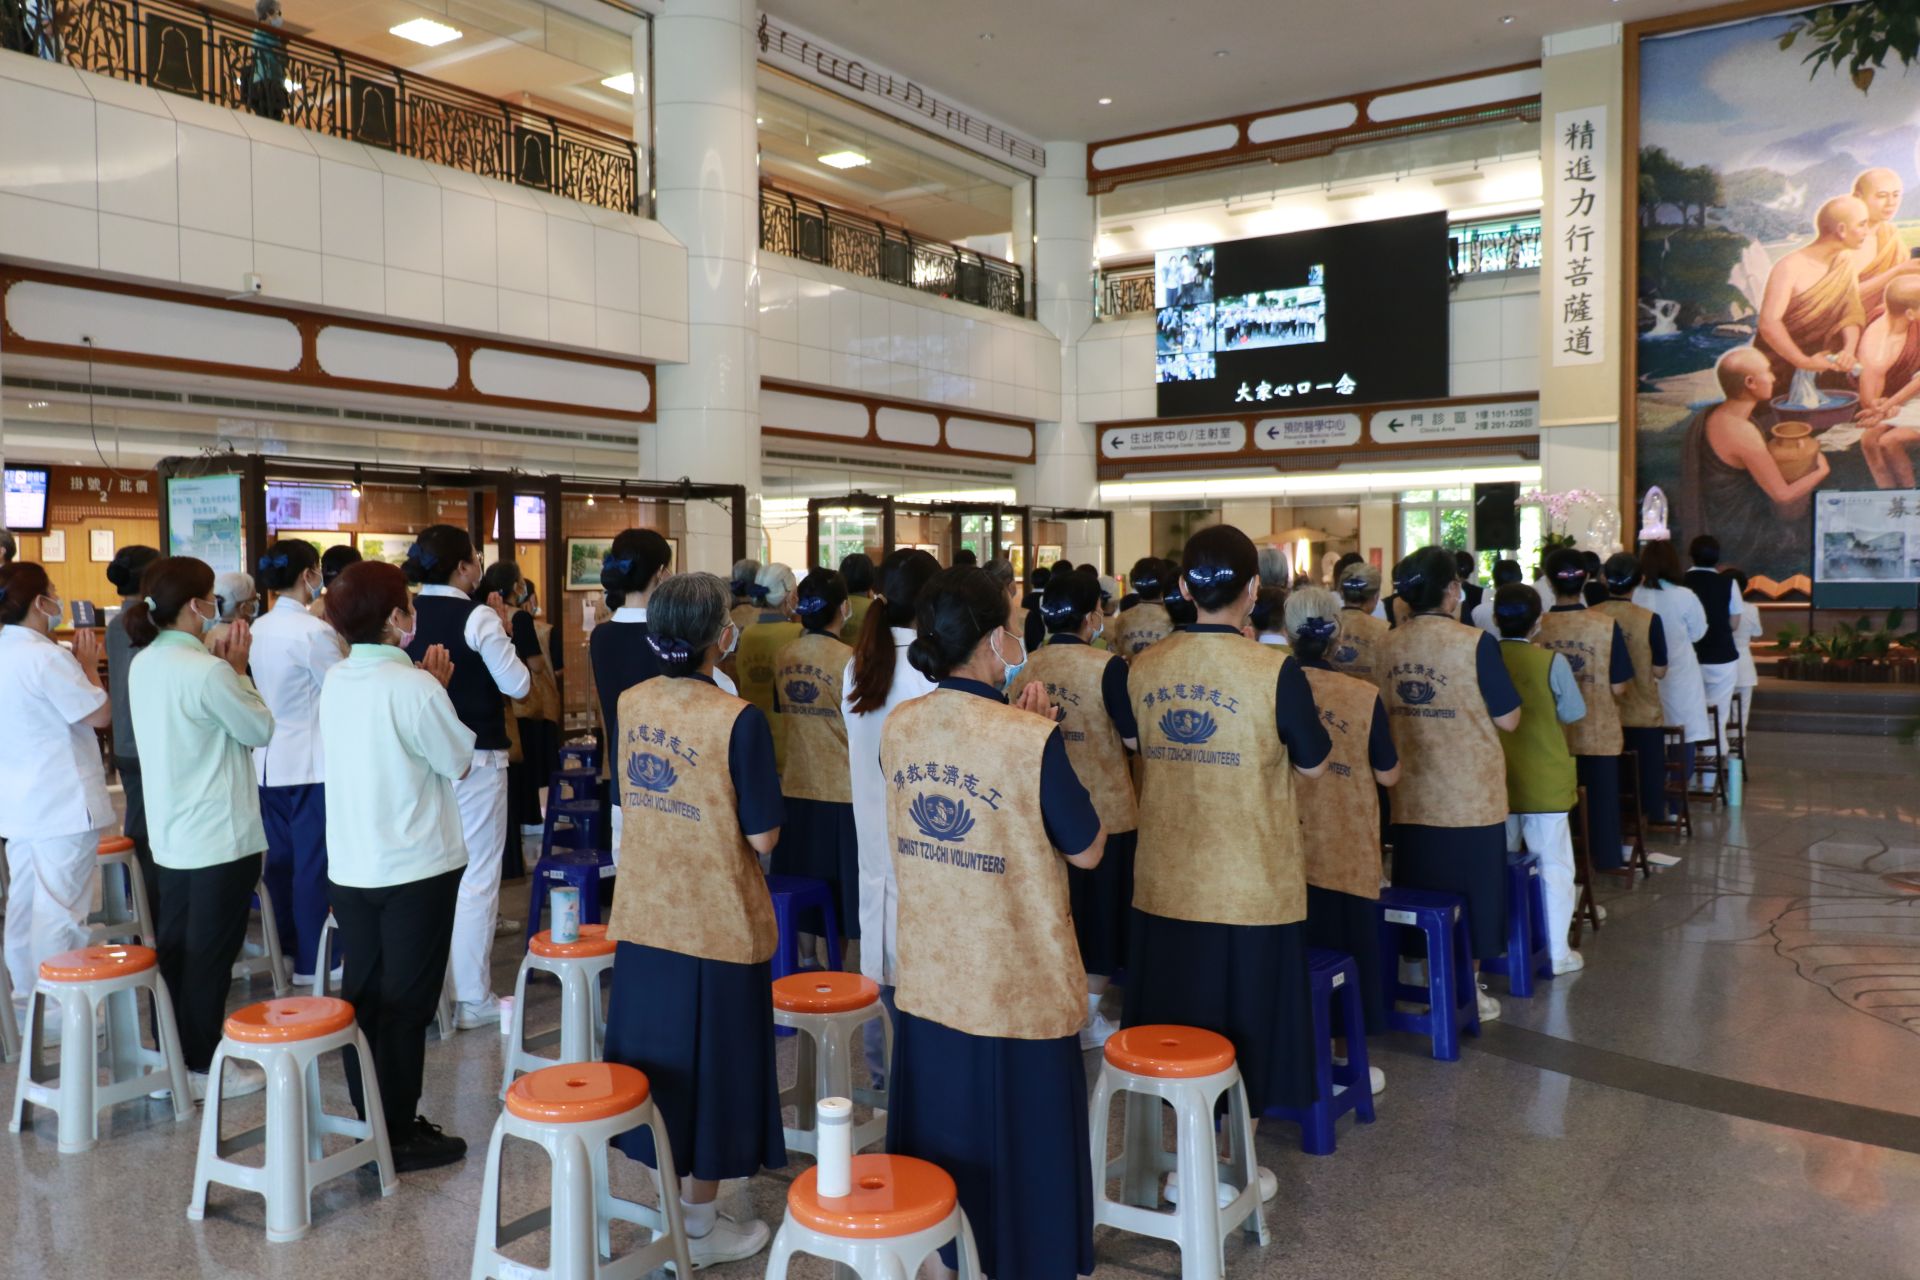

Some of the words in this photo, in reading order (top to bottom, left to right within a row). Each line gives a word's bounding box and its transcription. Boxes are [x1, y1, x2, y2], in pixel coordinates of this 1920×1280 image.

[1563, 119, 1597, 356] 精進力行菩薩道
[1235, 373, 1357, 402] 大家心口一念
[1284, 420, 1346, 433] 預防醫學中心
[1411, 411, 1467, 427] 門診區
[1130, 427, 1231, 444] 住出院中心/注射室
[100, 491, 108, 502] 2
[1143, 684, 1239, 714] 佛教慈濟志工
[1192, 749, 1240, 767] VOLUNTEERS
[894, 762, 1002, 810] 佛教慈濟志工
[655, 797, 701, 822] VOLUNTEERS
[919, 842, 949, 864] TZU-CHI
[951, 848, 1007, 875] VOLUNTEERS
